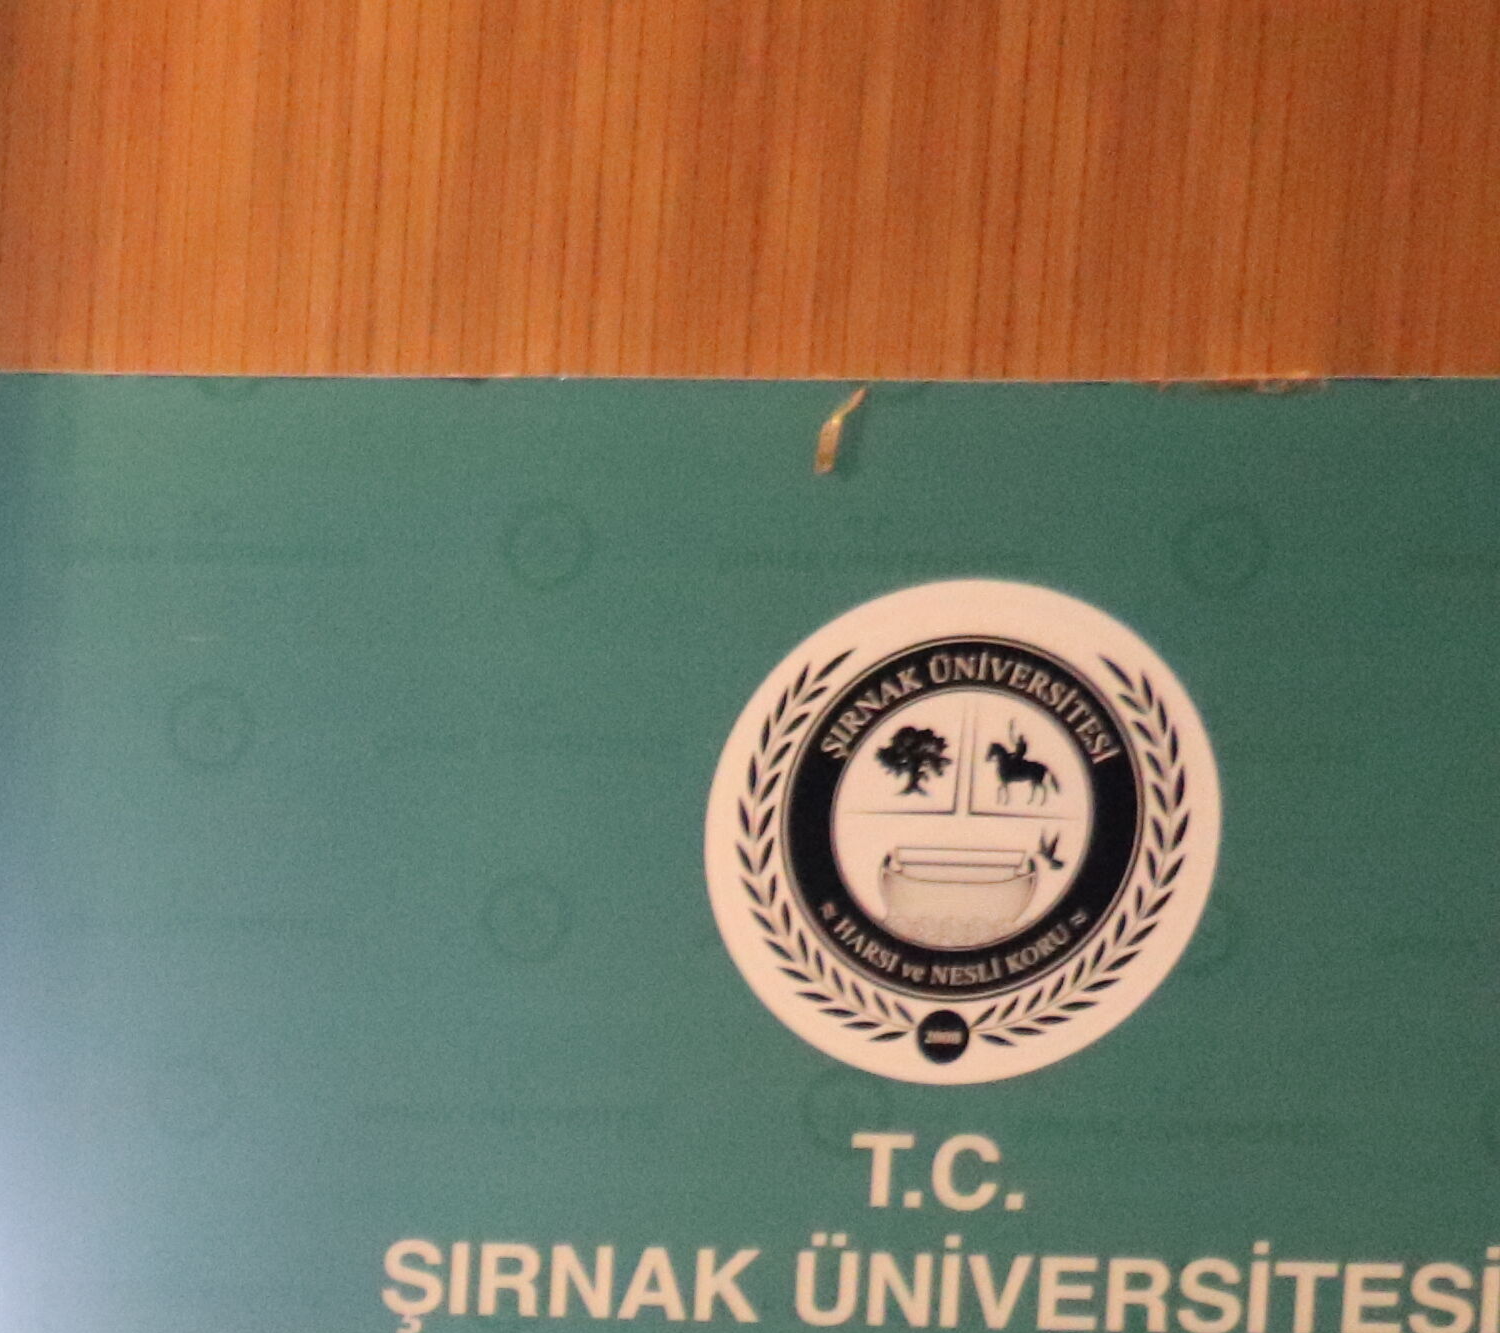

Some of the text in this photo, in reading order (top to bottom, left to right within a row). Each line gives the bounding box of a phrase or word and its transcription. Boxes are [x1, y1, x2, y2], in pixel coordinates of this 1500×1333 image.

[820, 650, 1121, 764] ŞIRNAK ÜNİVERSİTESİ
[902, 962, 926, 983] ve
[929, 959, 1001, 986] NESLİ
[1004, 923, 1072, 974] KORU
[852, 1132, 1025, 1210] T.C.
